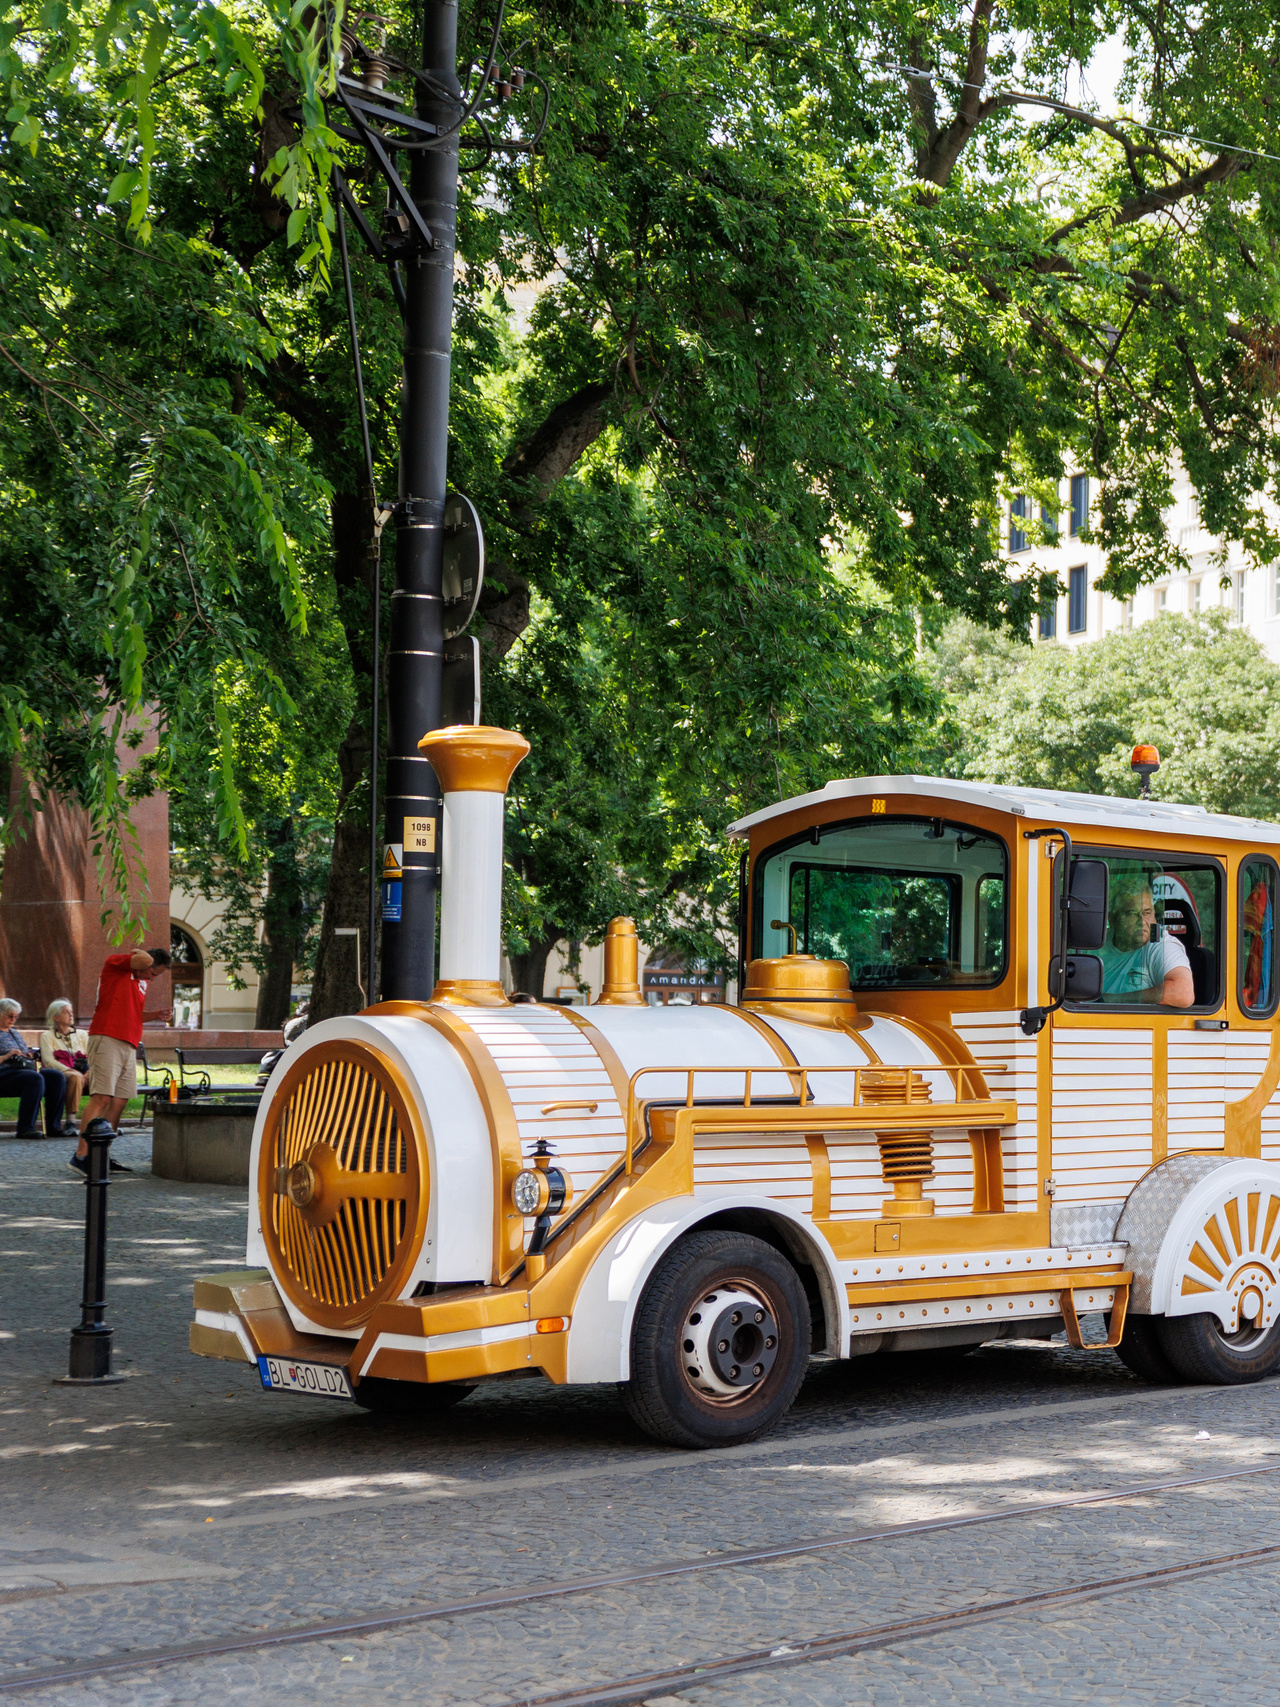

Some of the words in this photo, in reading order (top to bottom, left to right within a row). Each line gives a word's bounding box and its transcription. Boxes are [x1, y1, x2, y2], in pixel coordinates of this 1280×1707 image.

[416, 838, 427, 847] NB
[1152, 883, 1175, 896] CITY
[269, 1361, 291, 1387] BL
[295, 1365, 348, 1395] GOLD2
